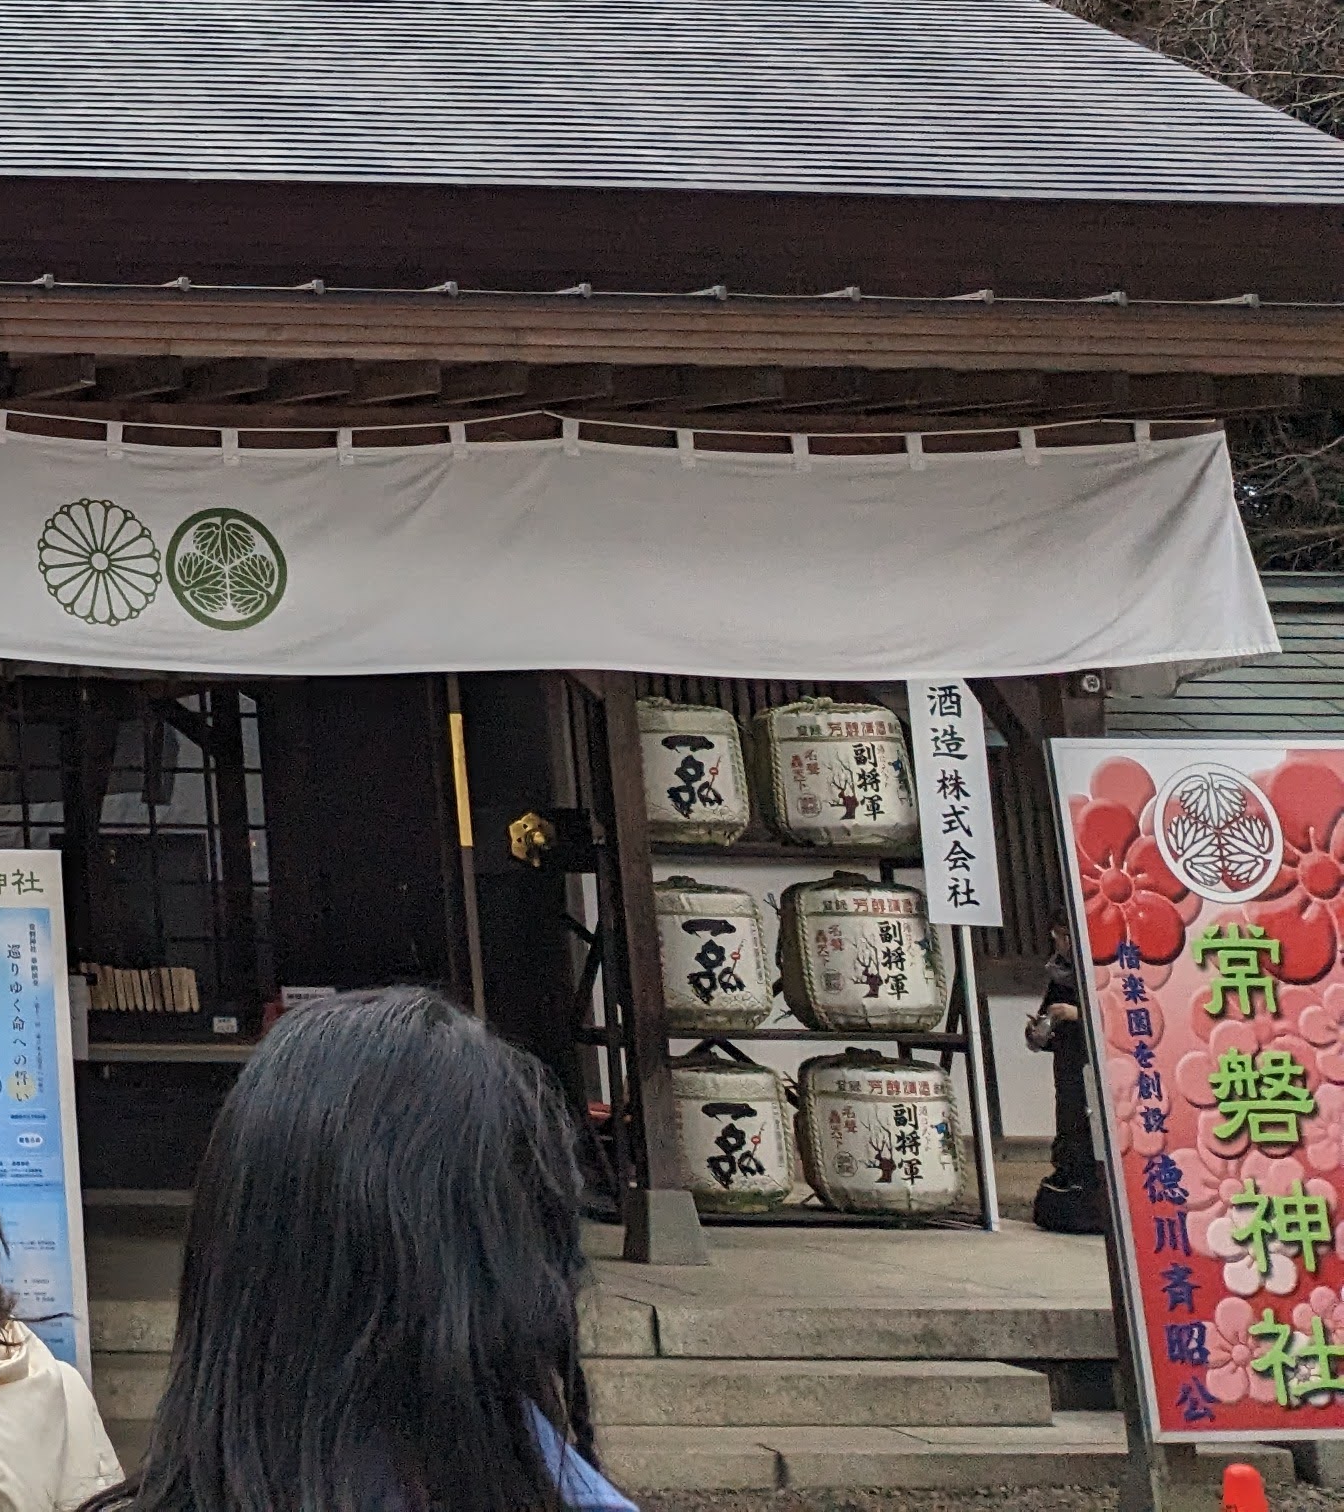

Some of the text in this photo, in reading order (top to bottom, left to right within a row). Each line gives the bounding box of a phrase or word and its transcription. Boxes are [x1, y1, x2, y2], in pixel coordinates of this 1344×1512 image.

[662, 734, 723, 819] 一品
[852, 743, 886, 821] 副将軍
[927, 685, 980, 909] 酒造株式会社
[682, 919, 745, 1005] 一品
[878, 920, 910, 1001] 副将軍
[700, 1102, 766, 1189] 一品
[892, 1104, 924, 1185] 副将軍
[1116, 940, 1221, 1423] 偕楽園を創設 徳川斉昭公
[1193, 922, 1344, 1405] 常磐神社
